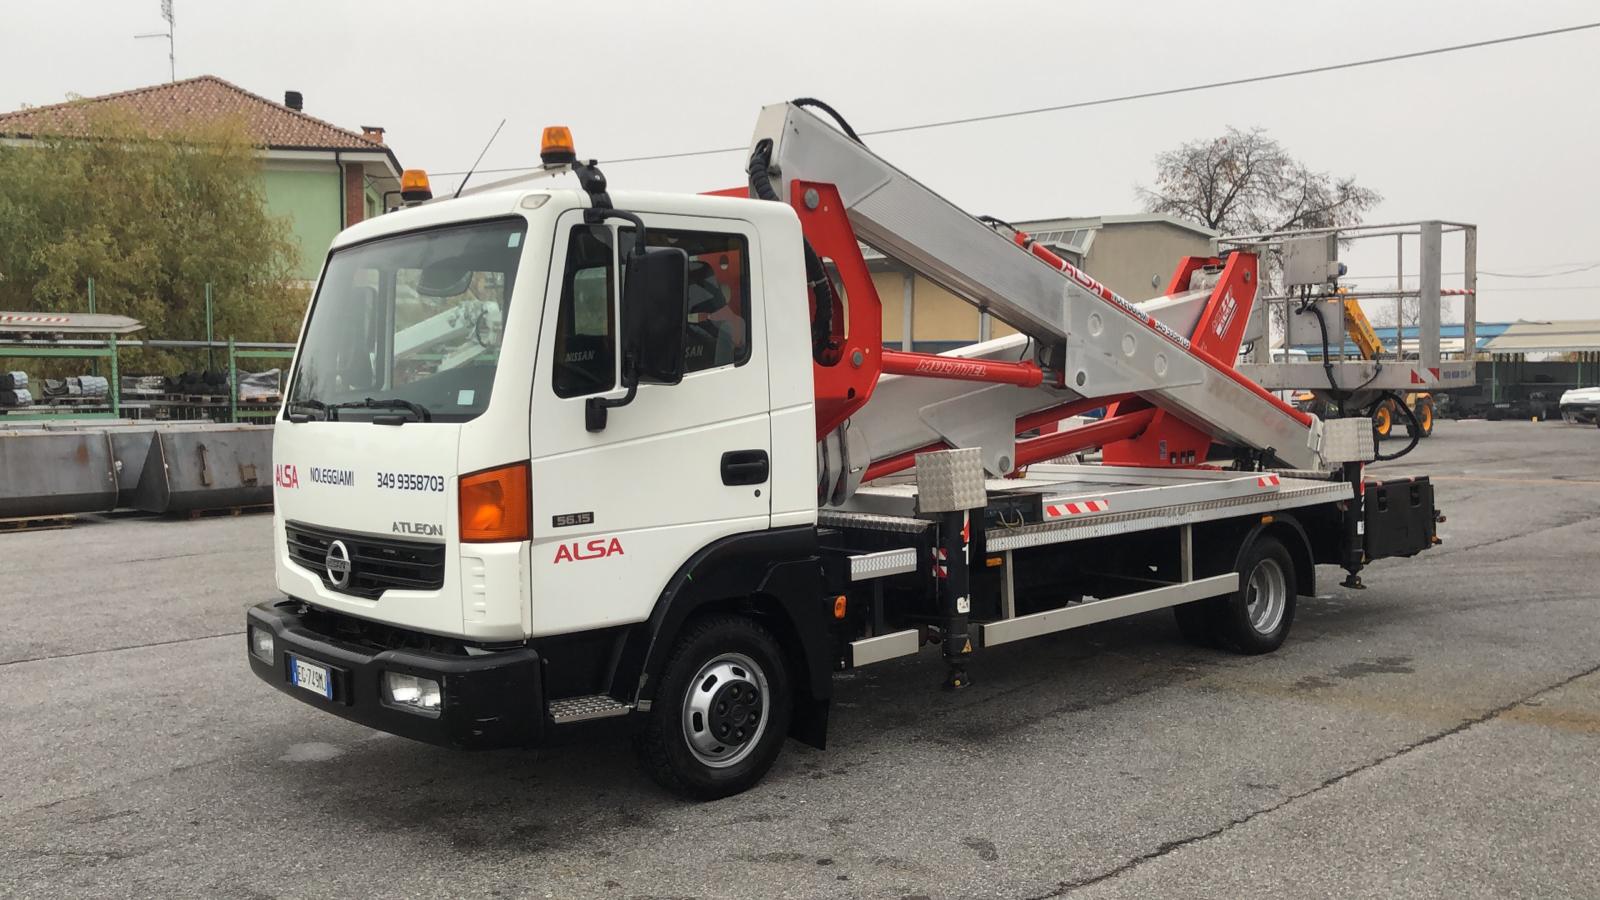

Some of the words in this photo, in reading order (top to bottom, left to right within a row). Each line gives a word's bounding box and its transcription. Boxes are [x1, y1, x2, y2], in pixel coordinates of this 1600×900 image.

[565, 350, 595, 362] NISSAN
[684, 345, 704, 359] SAN
[915, 359, 987, 377] MULTITEL
[275, 463, 299, 489] ALSA
[310, 466, 355, 487] NOLEGGIAMI
[377, 472, 396, 489] 349
[397, 473, 445, 493] 9358703
[557, 513, 591, 526] 56.15
[392, 521, 444, 536] ATLEON
[553, 537, 625, 564] ALSA
